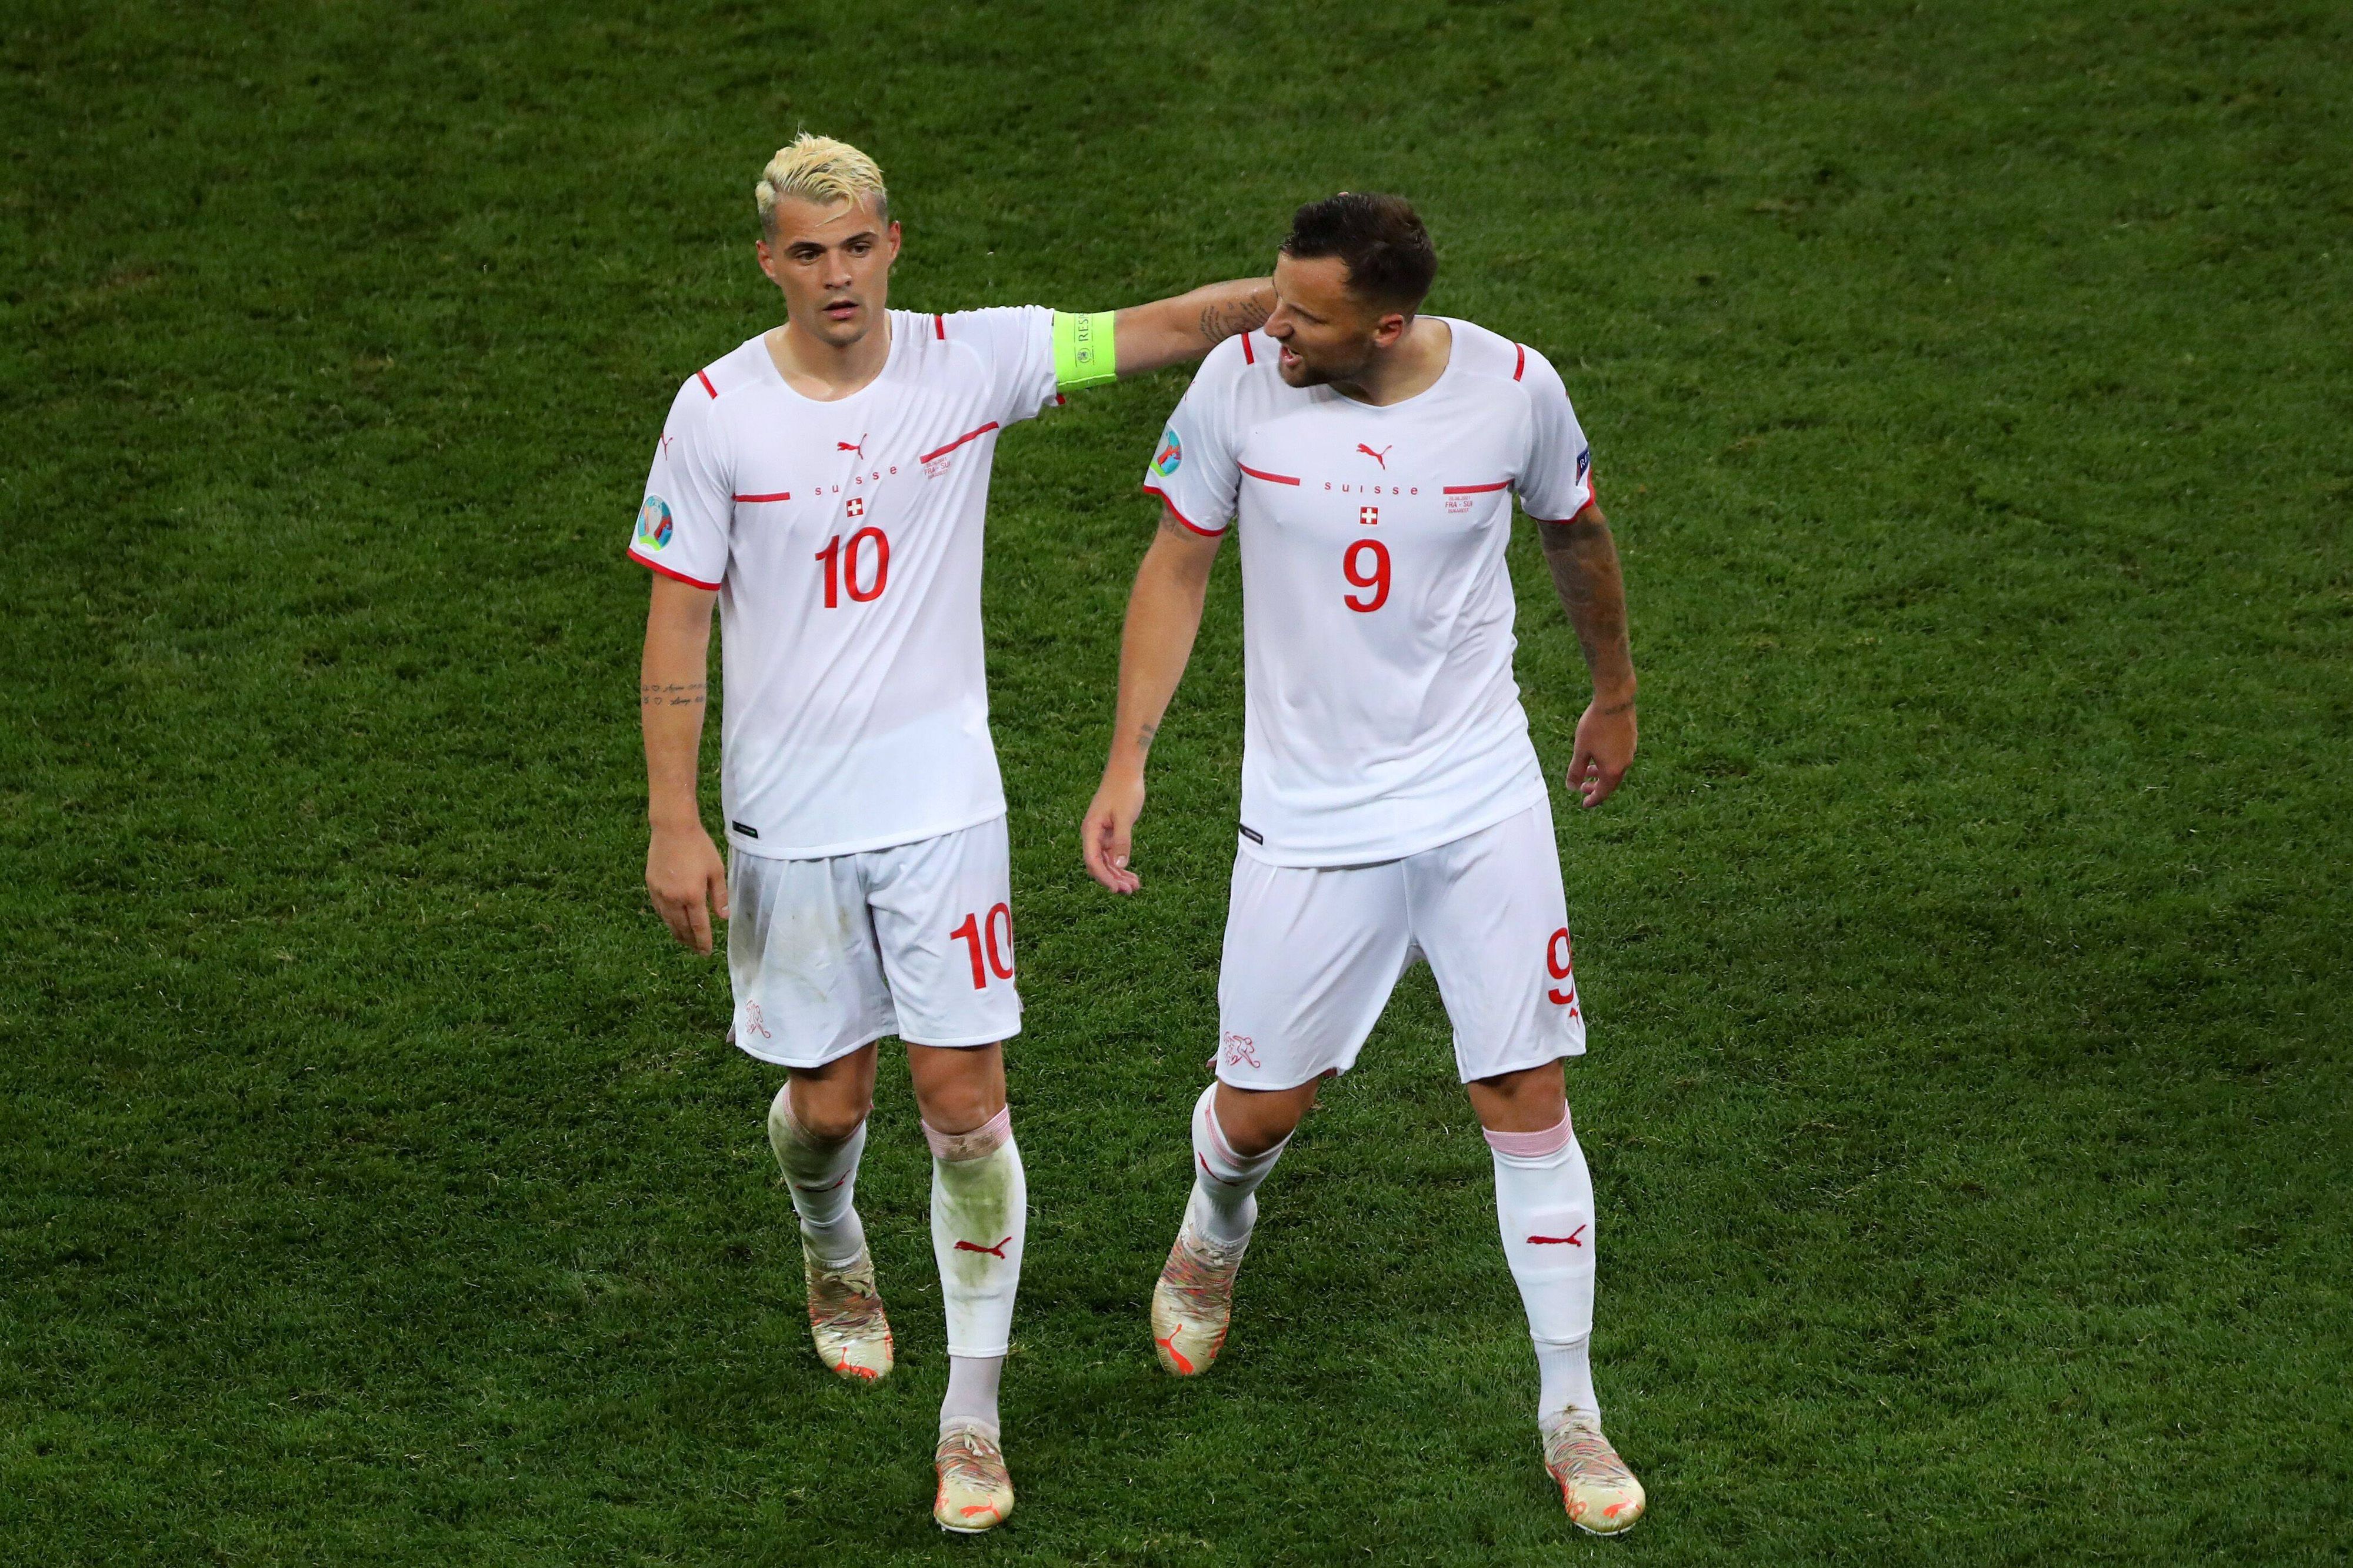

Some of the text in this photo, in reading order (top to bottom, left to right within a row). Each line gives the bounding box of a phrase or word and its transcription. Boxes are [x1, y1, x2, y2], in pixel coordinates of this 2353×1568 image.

[1078, 312, 1089, 342] RESP
[815, 466, 897, 495] susse
[941, 461, 951, 469] SUI
[1324, 482, 1418, 495] suisse
[815, 525, 891, 609] 10
[1344, 538, 1392, 614] 9
[949, 902, 1014, 990] 10
[1547, 927, 1574, 1005] 9
